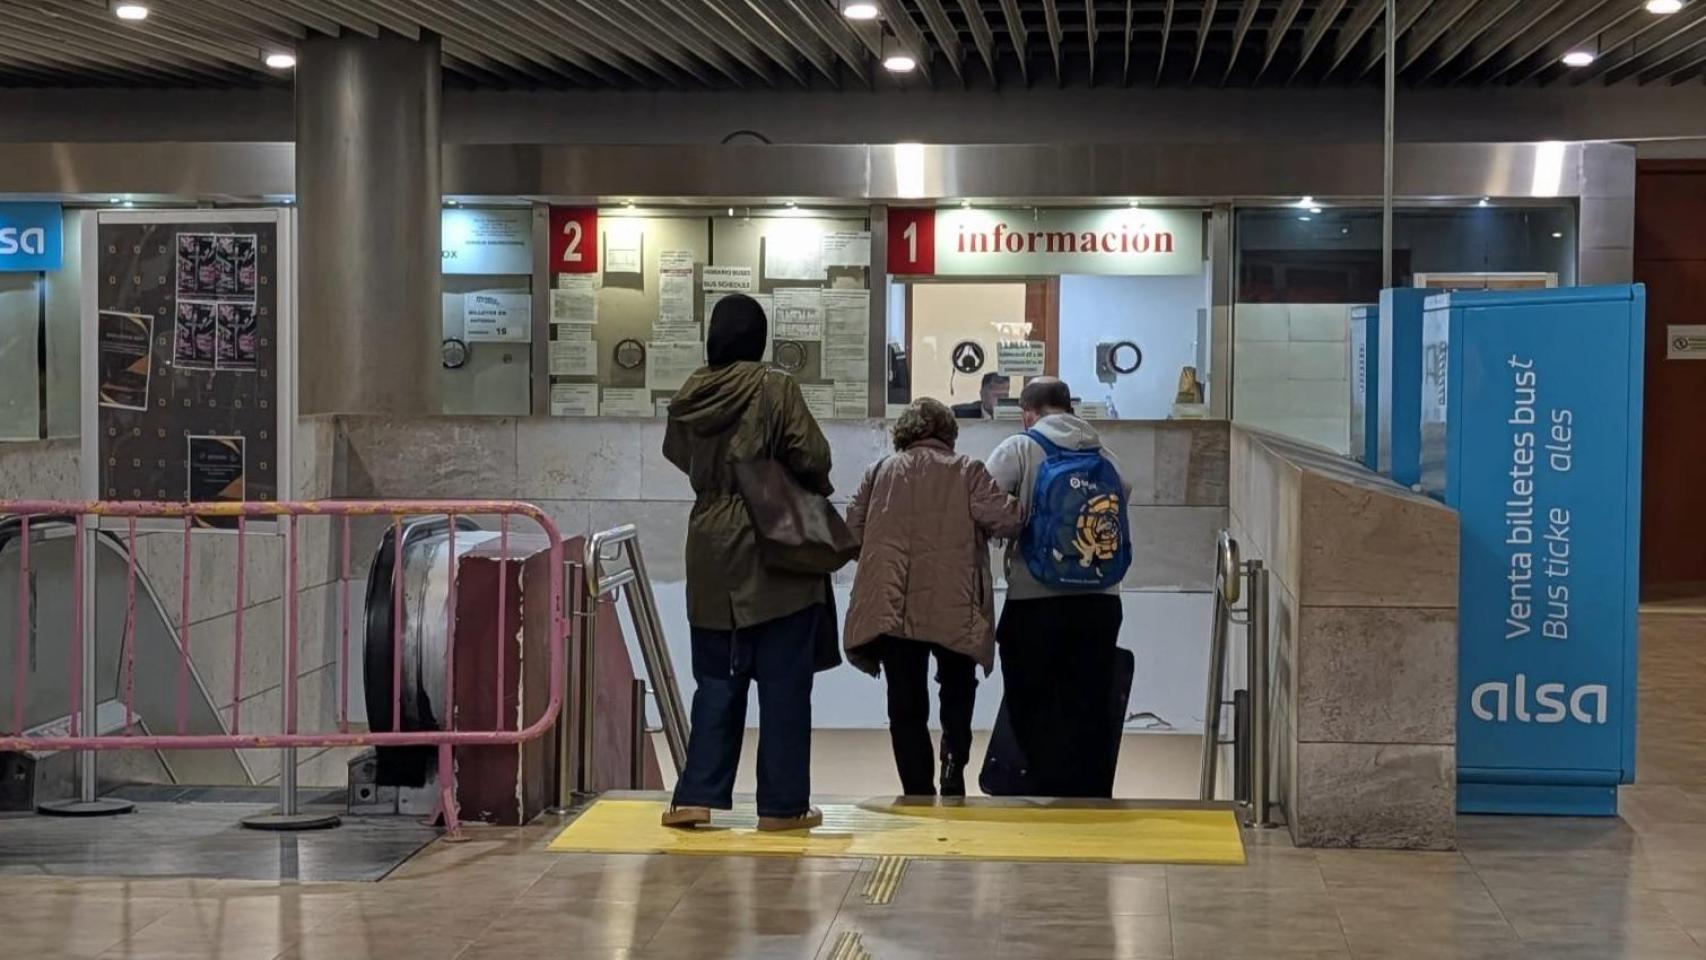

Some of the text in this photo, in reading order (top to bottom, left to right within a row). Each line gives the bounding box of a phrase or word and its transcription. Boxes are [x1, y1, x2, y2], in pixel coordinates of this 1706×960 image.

[563, 221, 582, 262] 2
[903, 222, 917, 263] 1
[956, 223, 1174, 253] información
[1506, 432, 1535, 544] billetes
[1506, 553, 1532, 638] Venta
[1543, 586, 1568, 639] Bus
[1471, 674, 1607, 724] alsa
